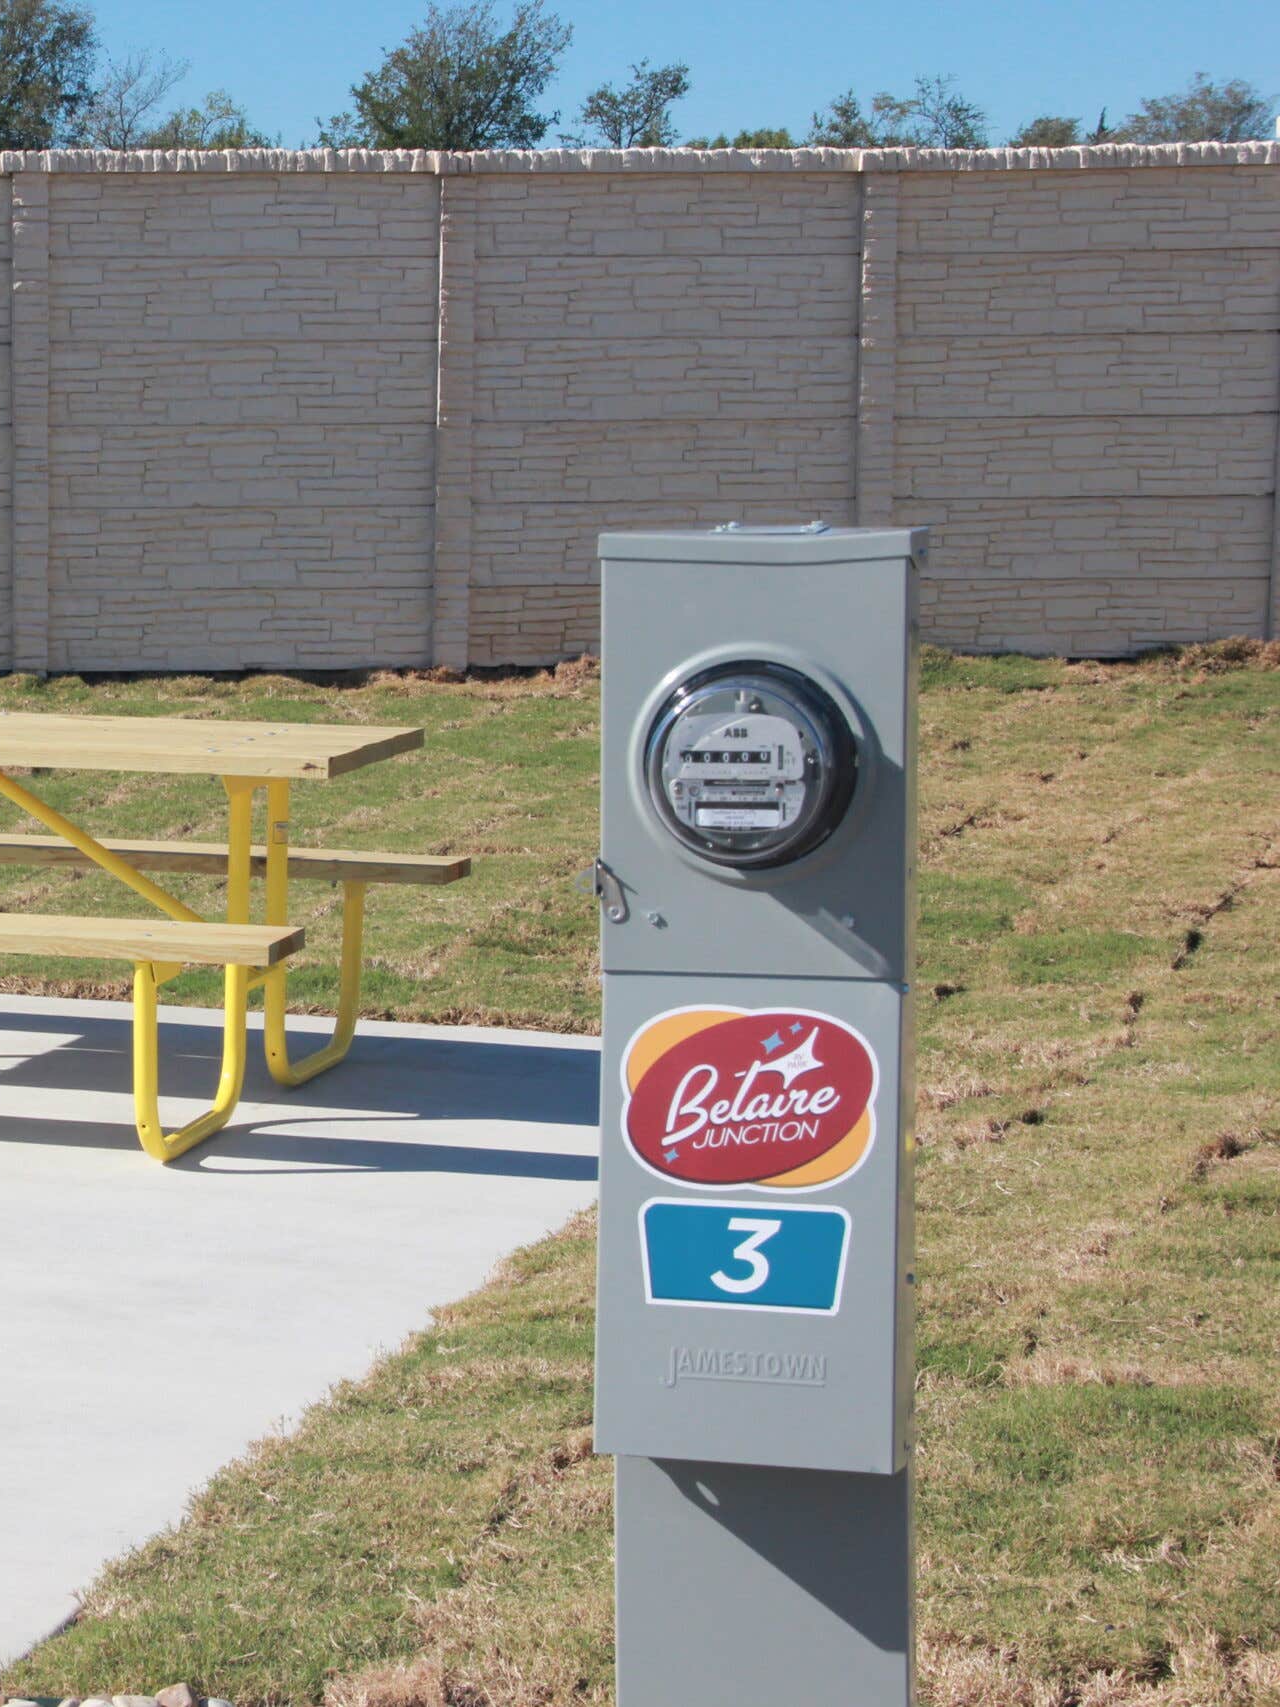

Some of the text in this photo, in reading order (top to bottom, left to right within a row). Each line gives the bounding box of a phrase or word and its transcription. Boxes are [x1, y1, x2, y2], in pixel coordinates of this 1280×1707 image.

[724, 728, 748, 738] ABB
[661, 1061, 841, 1147] Belaire
[693, 1120, 820, 1149] JUNCTION
[710, 1217, 782, 1294] 3
[666, 1345, 828, 1388] JAMESTOWN
